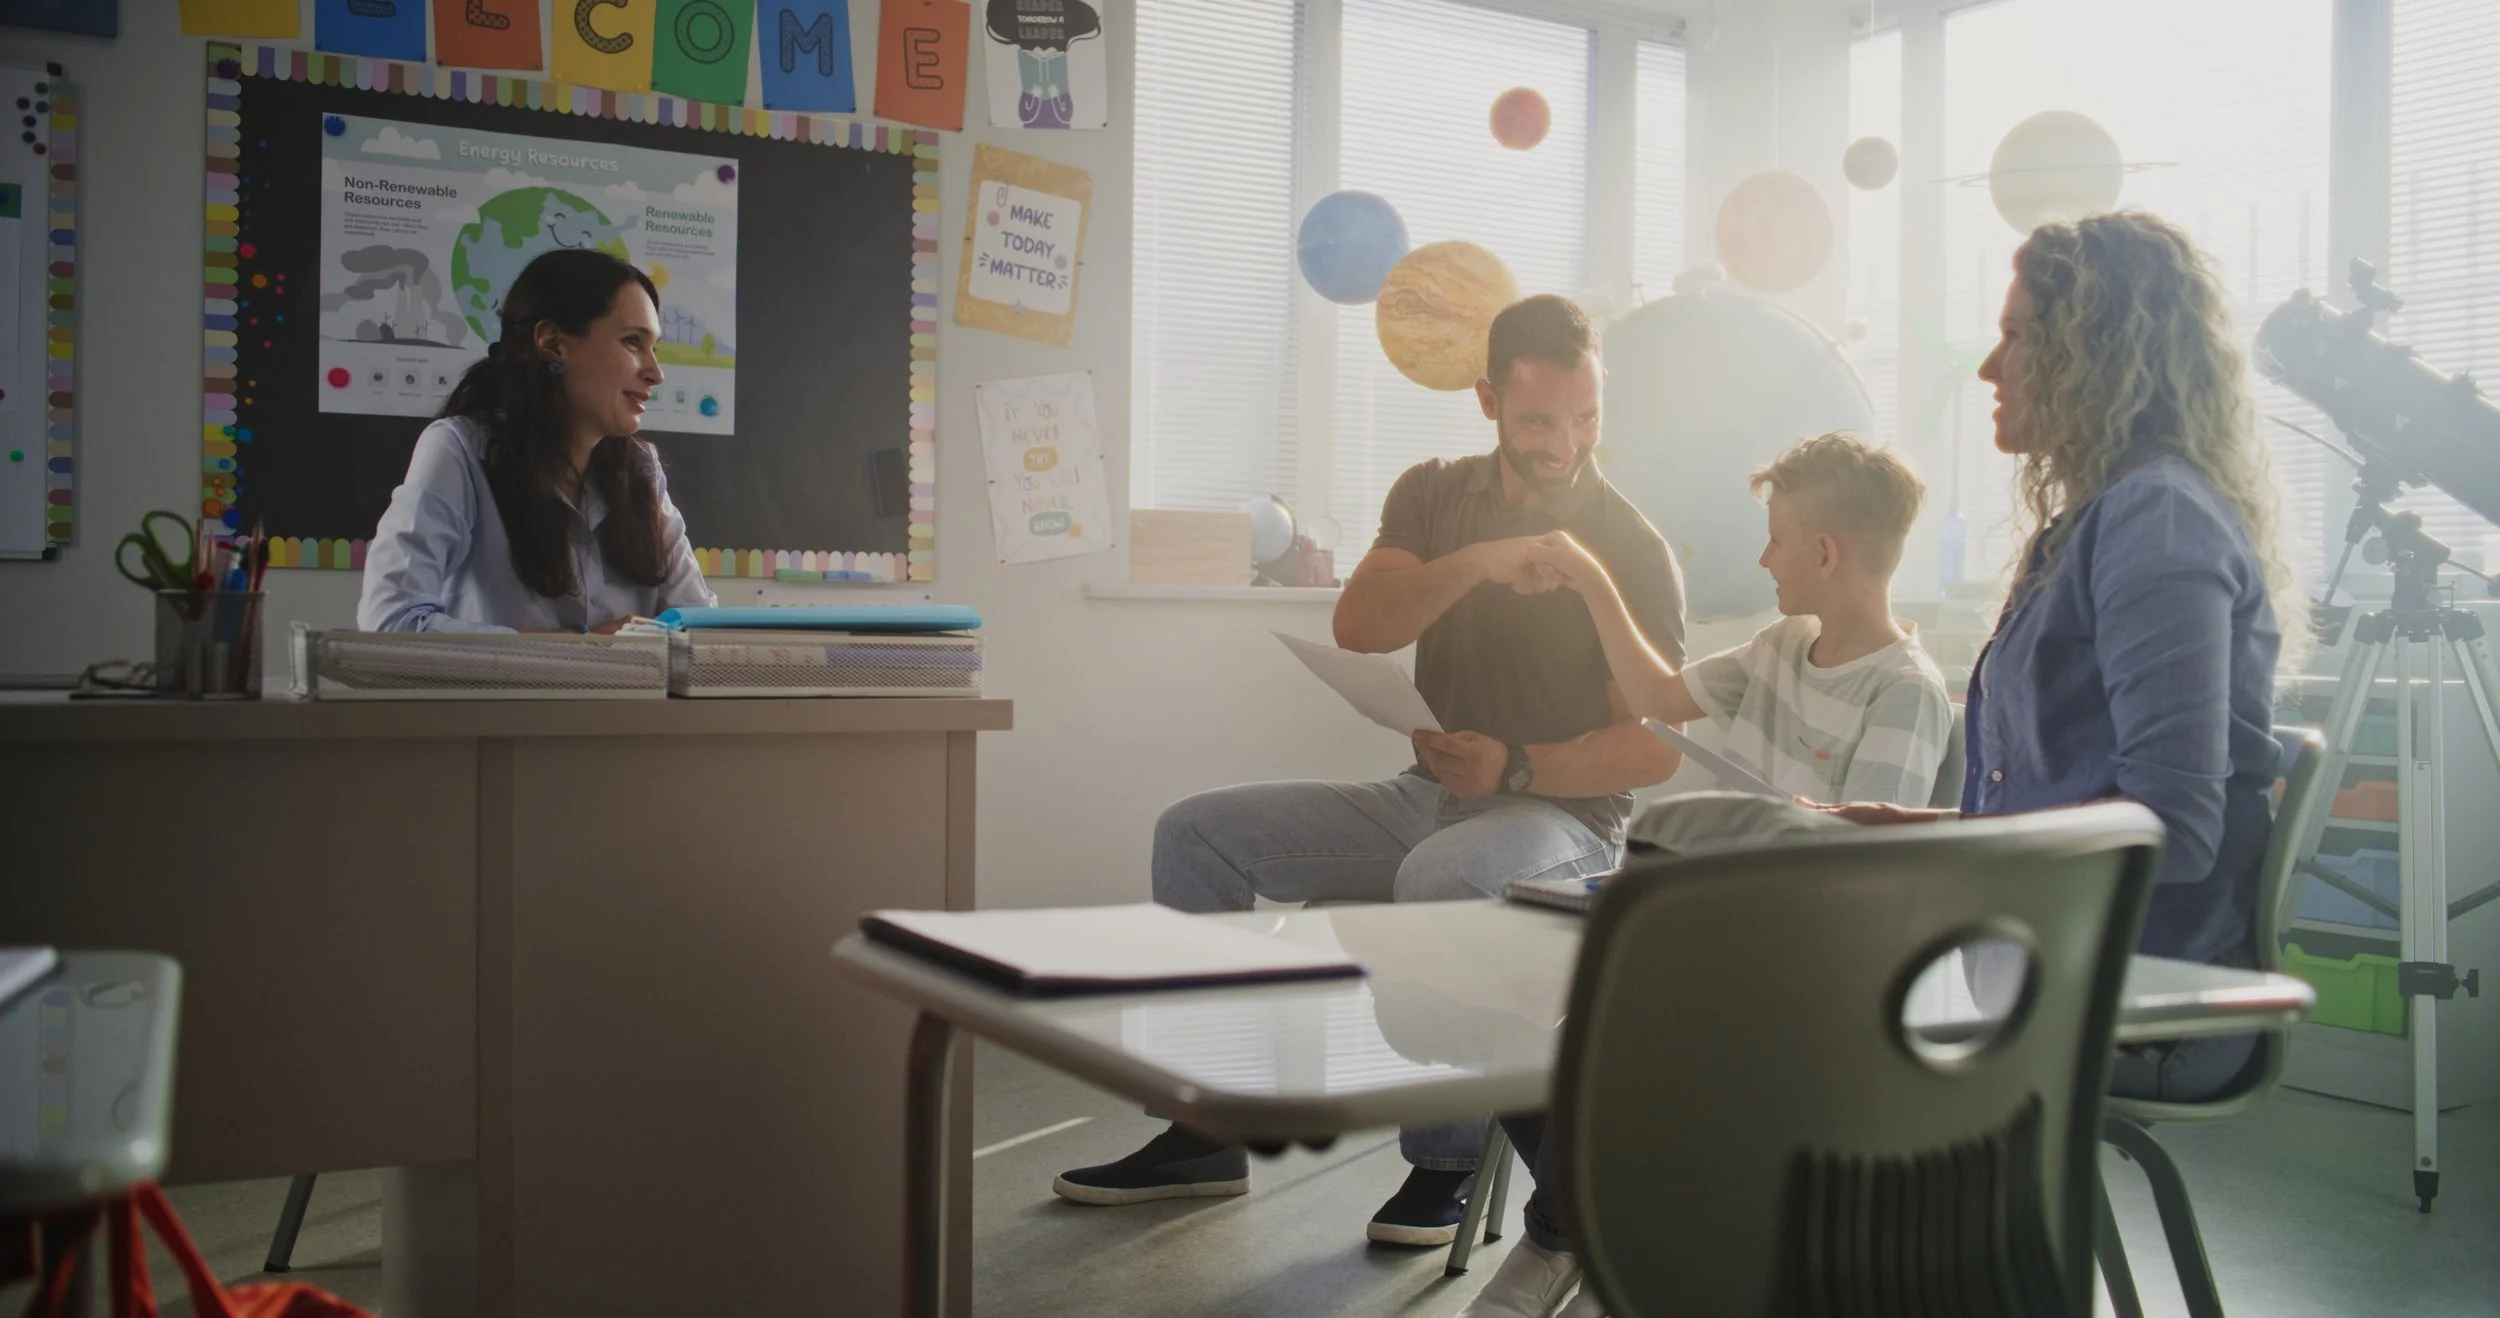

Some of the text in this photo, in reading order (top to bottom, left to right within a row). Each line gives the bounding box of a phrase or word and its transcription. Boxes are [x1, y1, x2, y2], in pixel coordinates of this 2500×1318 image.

[458, 140, 619, 172] Energy Resources
[344, 175, 457, 198] Non-Renewable
[344, 191, 421, 209] Resources
[645, 206, 715, 224] Renewable
[1010, 204, 1054, 229] MAKE
[645, 220, 713, 238] Resources
[1001, 230, 1056, 259] TODAY
[990, 258, 1056, 289] MATTER
